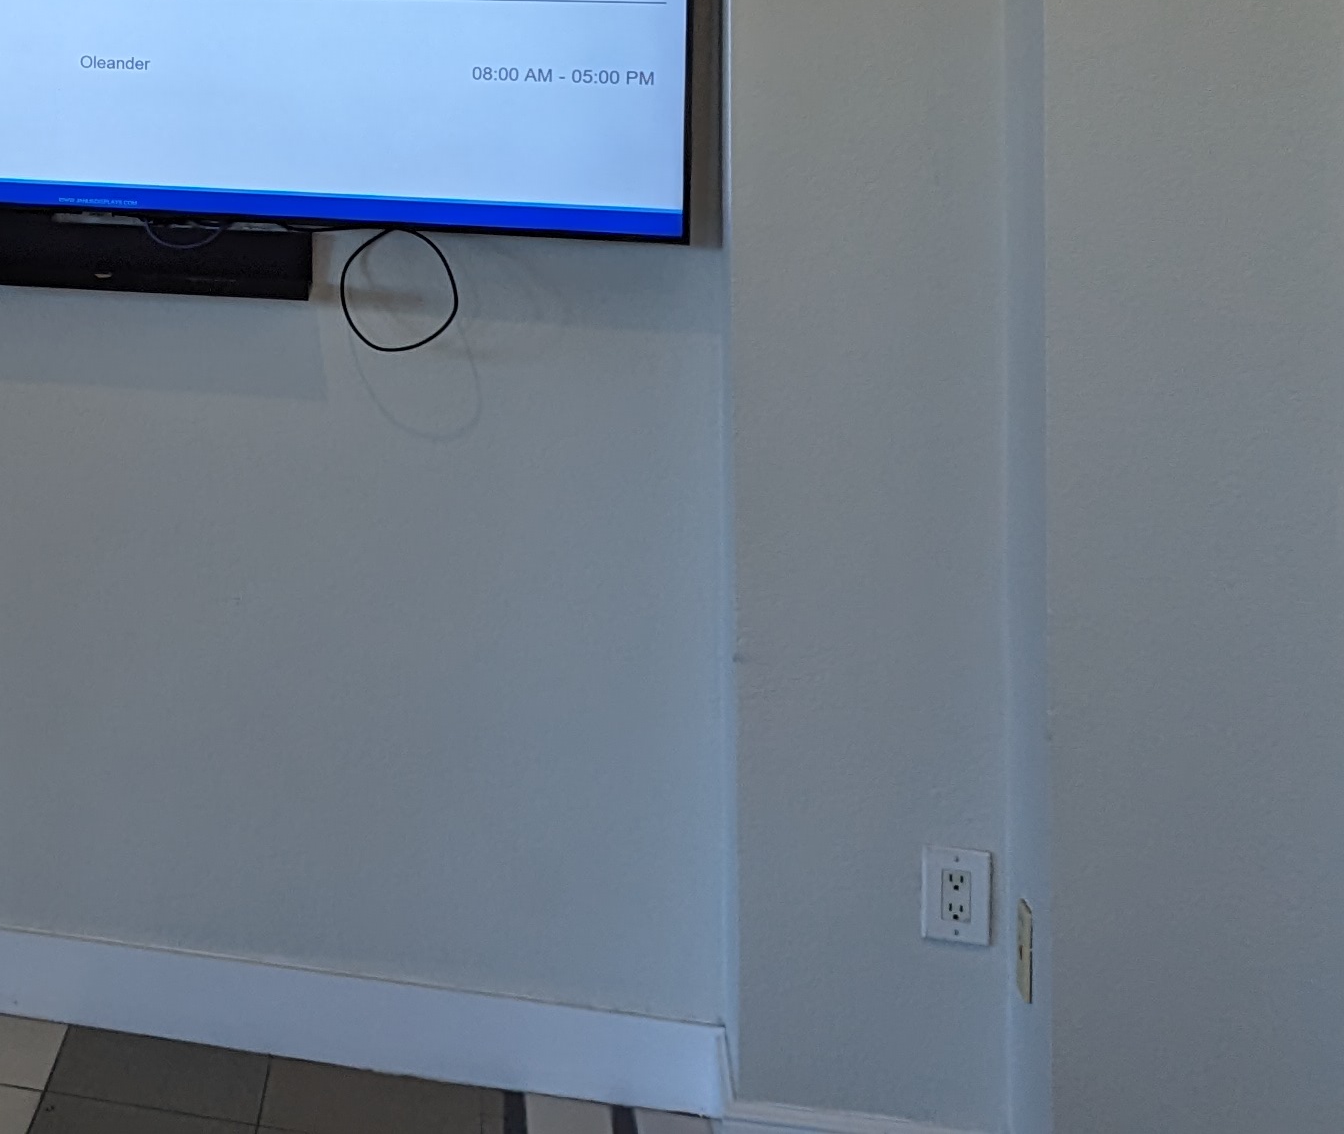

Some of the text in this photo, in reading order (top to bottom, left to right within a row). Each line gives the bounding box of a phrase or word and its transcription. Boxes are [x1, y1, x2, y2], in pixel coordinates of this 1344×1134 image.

[80, 55, 150, 70] Oleander
[472, 66, 519, 81] 08:00
[524, 68, 553, 82] AM
[571, 69, 620, 84] 05:00
[626, 71, 654, 85] PM
